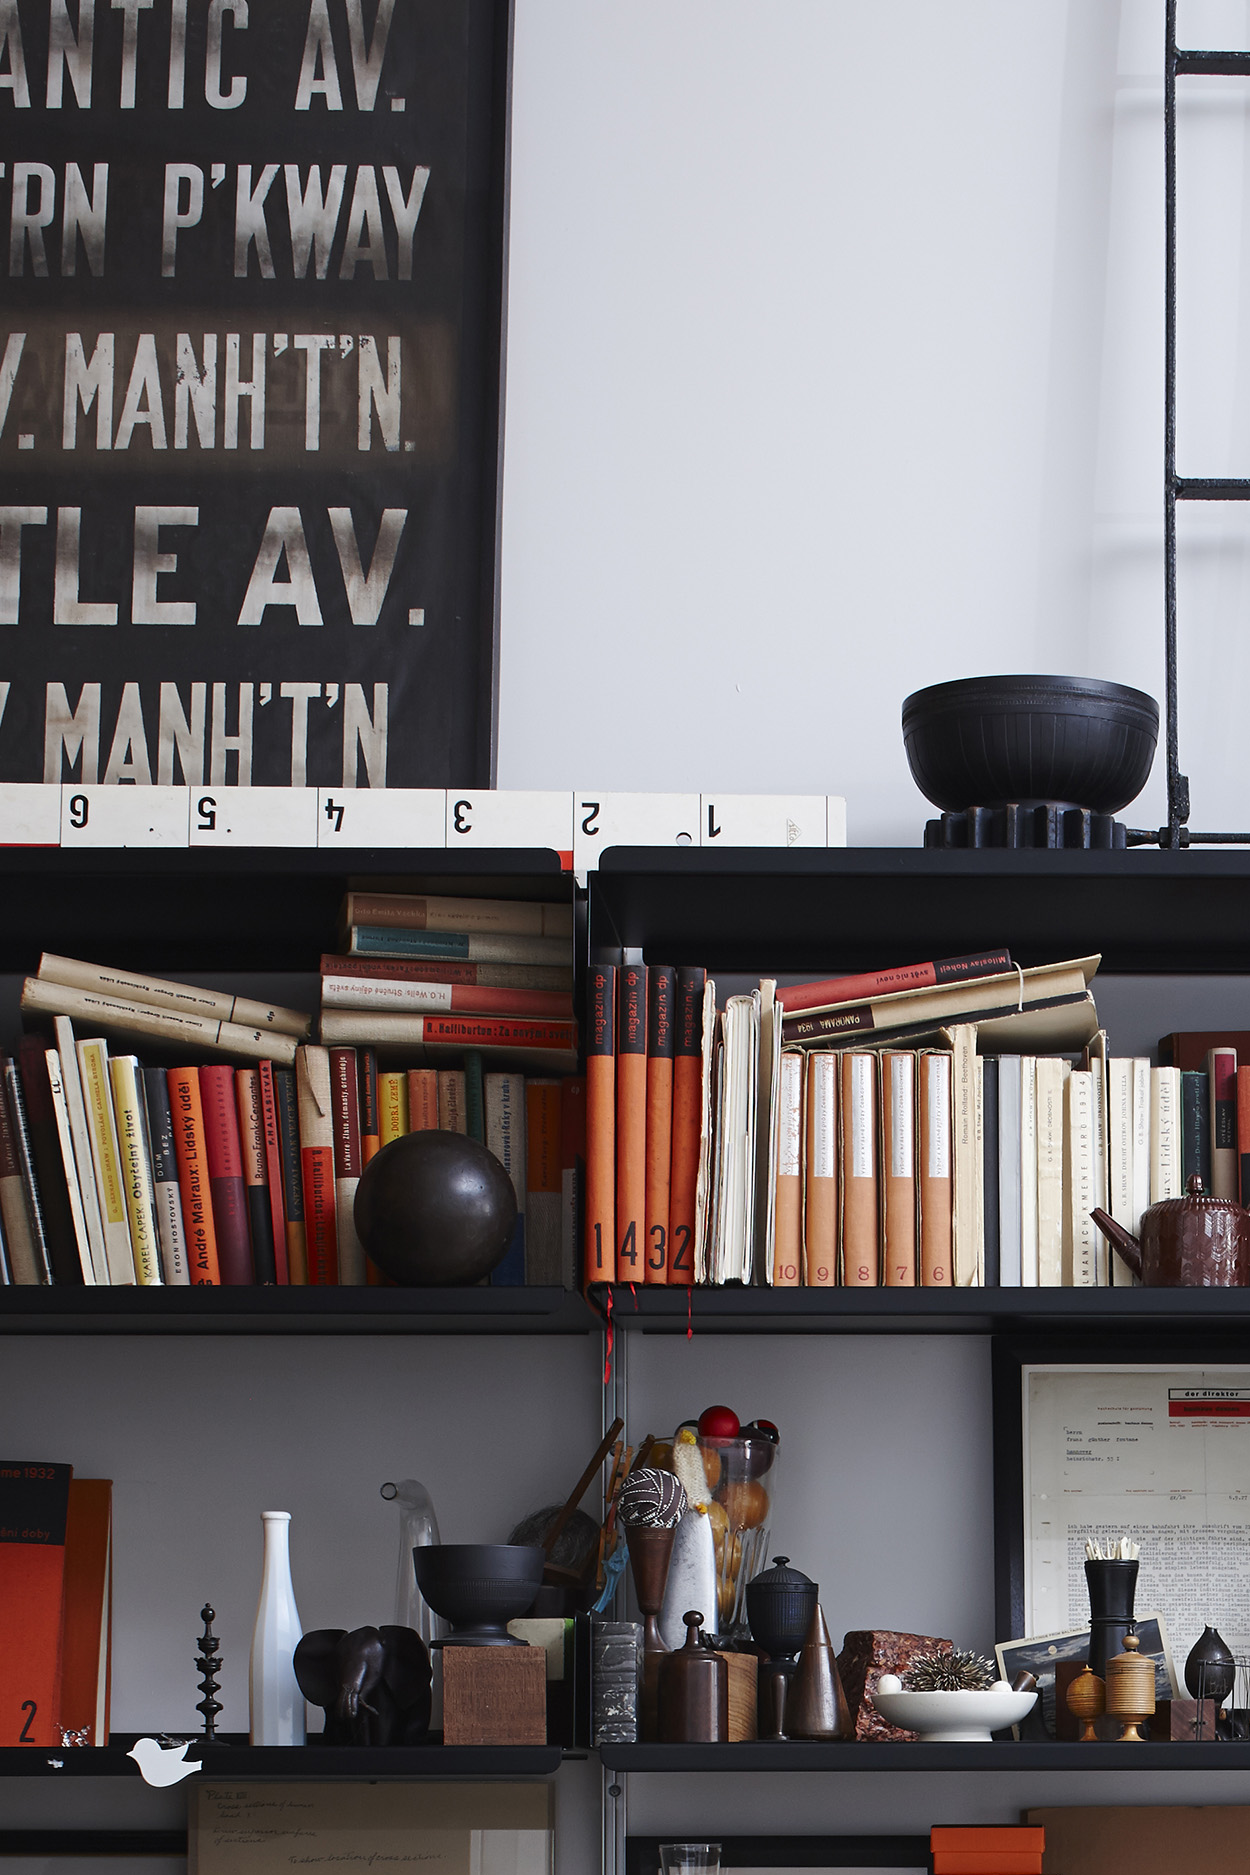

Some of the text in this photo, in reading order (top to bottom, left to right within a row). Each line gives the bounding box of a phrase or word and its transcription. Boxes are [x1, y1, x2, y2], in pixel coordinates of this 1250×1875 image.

[294, 0, 406, 111] AV.
[161, 162, 431, 281] P'KWAY
[237, 506, 425, 626] AV.
[43, 682, 389, 790] MANH'T'N
[198, 796, 216, 830] 5
[324, 798, 345, 832] 4
[453, 800, 472, 834] 3
[581, 802, 600, 836] 2
[708, 803, 721, 838] 1
[590, 974, 607, 1046] magazin dp
[624, 972, 640, 1044] magazin dp
[654, 975, 670, 1048] magazin dp
[680, 995, 695, 1048] magazin
[797, 1013, 861, 1034] PANORAMA 1934
[387, 1079, 400, 1132] DOBRÁ ZEMĚ
[160, 1134, 171, 1157] BEZ
[177, 1081, 210, 1271] André Malraux: Lidský úděl
[166, 1186, 183, 1276] EGON HOSTOVSKÝ
[593, 1222, 603, 1270] 1
[620, 1220, 637, 1268] 4
[648, 1224, 666, 1271] 3
[674, 1224, 692, 1272] 2
[778, 1264, 798, 1281] 10
[816, 1266, 830, 1282] 9
[858, 1266, 871, 1281] 8
[896, 1265, 909, 1281] 7
[932, 1266, 945, 1282] 6
[24, 1466, 55, 1480] 1932
[18, 1699, 38, 1743] 2
